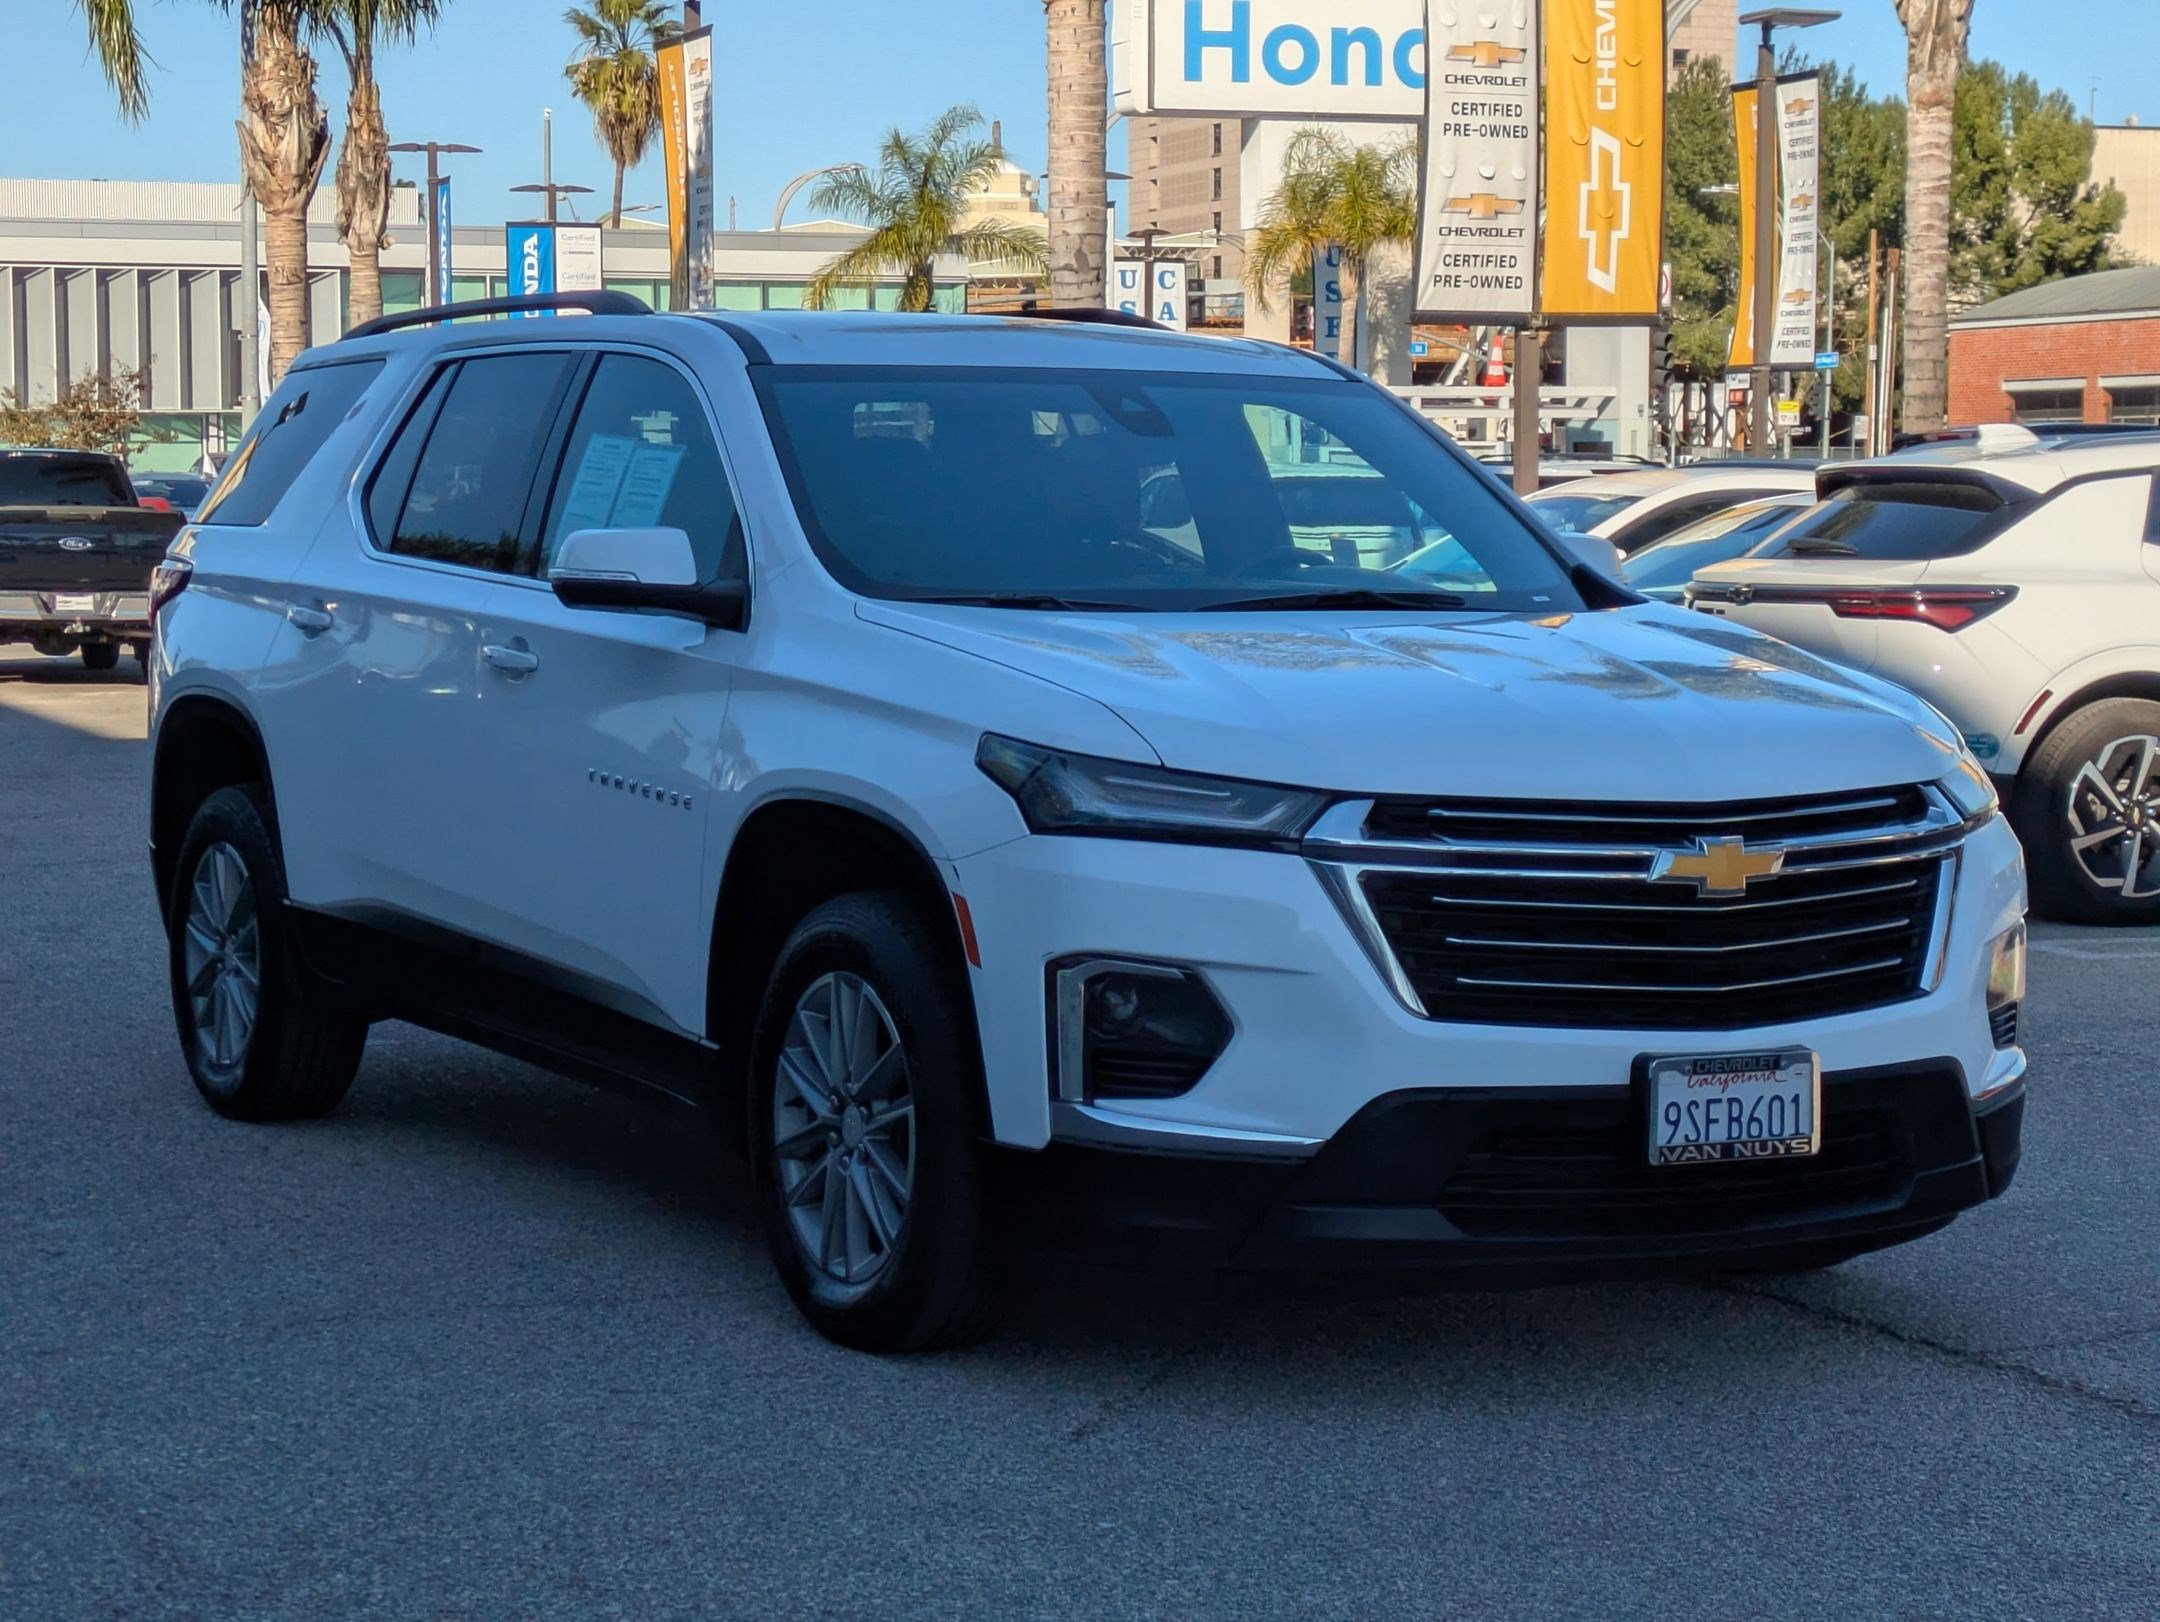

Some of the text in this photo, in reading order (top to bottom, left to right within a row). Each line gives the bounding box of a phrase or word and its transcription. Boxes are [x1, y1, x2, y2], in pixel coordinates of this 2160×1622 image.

[1444, 74, 1528, 87] CHEVROLET
[1451, 102, 1523, 118] CERTIFIED
[1443, 123, 1529, 139] PRE-OWNED
[1438, 226, 1526, 238] CHEVROLET
[1442, 254, 1518, 269] CERTIFIED
[1433, 274, 1523, 290] PRE-OWNED
[1324, 246, 1342, 359] USE
[588, 767, 693, 811] TRAVERSE
[1696, 1056, 1777, 1074] CHEVROLET
[1664, 1093, 1807, 1145] 9SFB601
[1662, 1138, 1811, 1163] VAN NUYS
